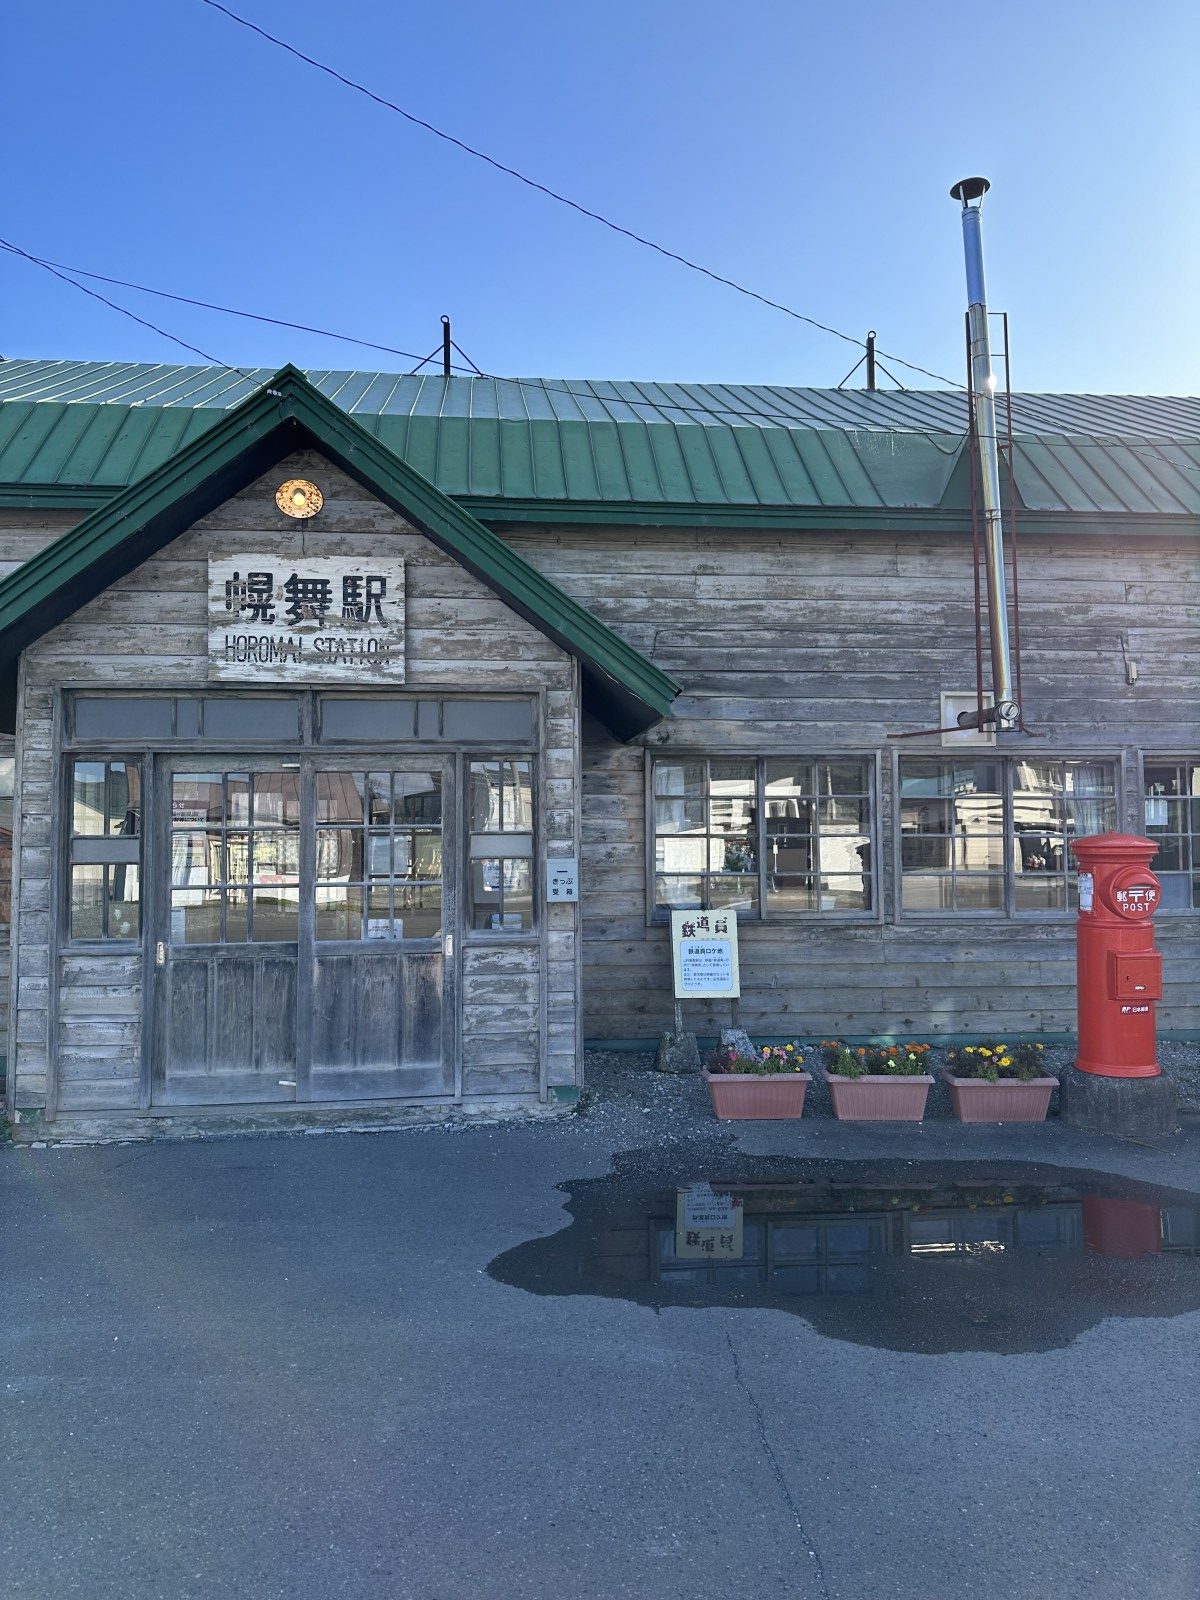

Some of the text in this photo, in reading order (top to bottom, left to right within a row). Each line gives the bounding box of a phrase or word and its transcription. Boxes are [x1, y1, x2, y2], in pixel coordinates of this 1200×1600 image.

[225, 571, 388, 628] 幌舞駅
[225, 634, 303, 663] HOROMAI
[1123, 902, 1150, 912] POST
[681, 915, 728, 938] 鉄道員
